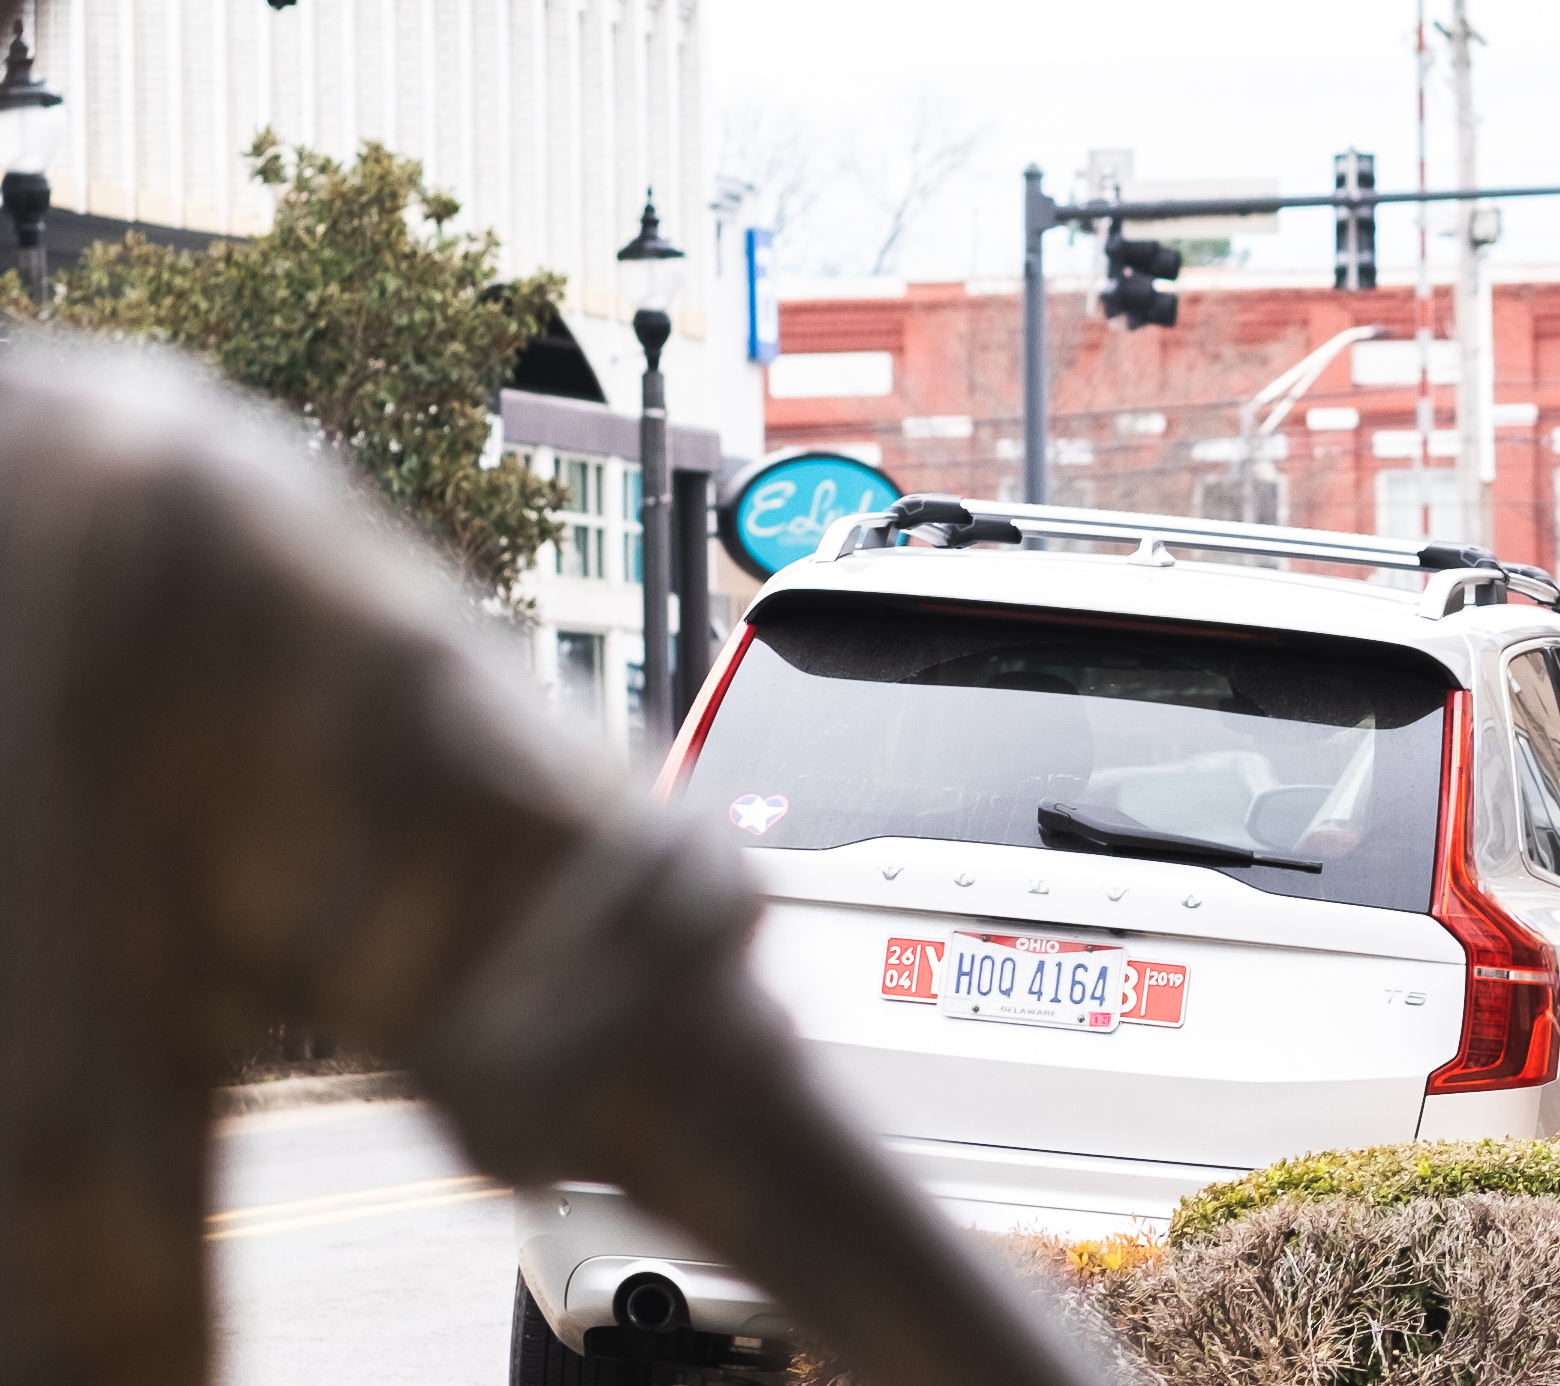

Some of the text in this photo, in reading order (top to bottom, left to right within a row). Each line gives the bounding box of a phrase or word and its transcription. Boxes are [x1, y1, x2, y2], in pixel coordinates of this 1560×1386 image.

[1015, 937, 1060, 954] OHIO
[888, 945, 914, 966] 26
[885, 969, 912, 990] 04
[1028, 960, 1109, 1008] 4164
[1148, 970, 1185, 988] 2019
[1000, 1005, 1056, 1018] DELAWARE
